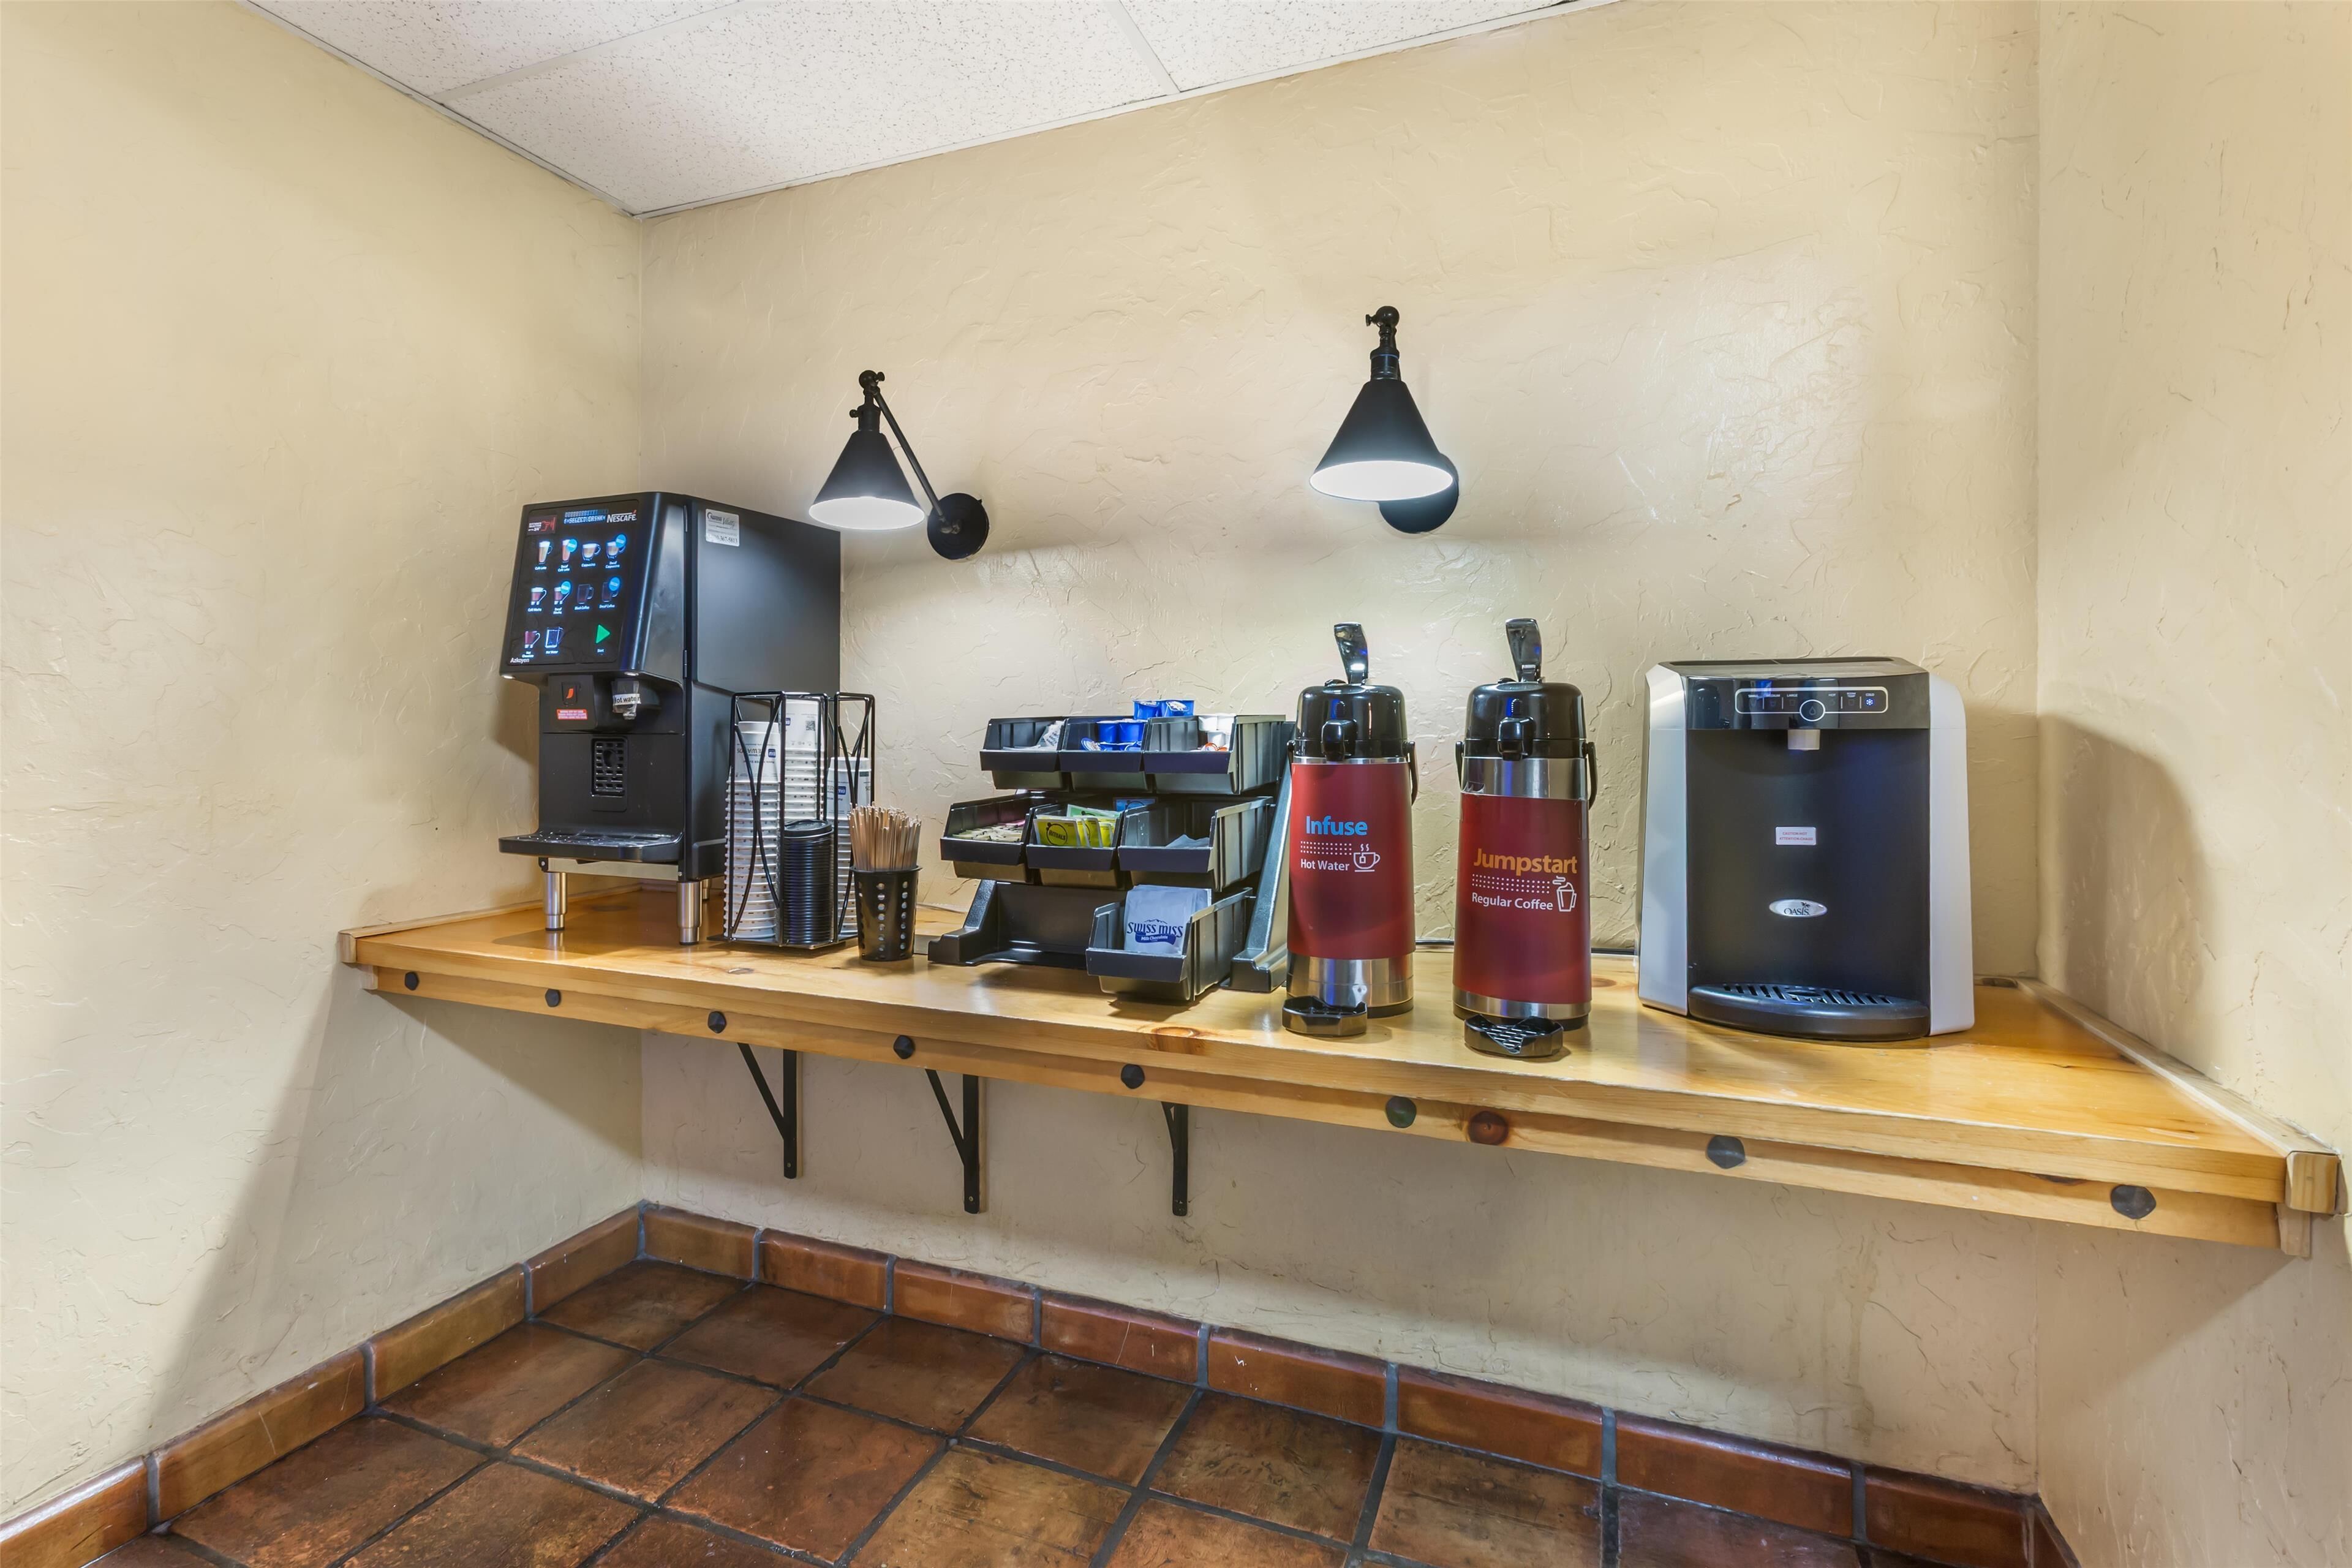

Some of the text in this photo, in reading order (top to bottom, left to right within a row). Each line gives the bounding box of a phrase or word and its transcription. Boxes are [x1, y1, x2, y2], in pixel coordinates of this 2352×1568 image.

[1306, 815, 1368, 835] Infuse
[1300, 858, 1350, 870] Hot Water
[1474, 848, 1578, 876] Jumpstart
[1472, 892, 1553, 910] Regular Coffee
